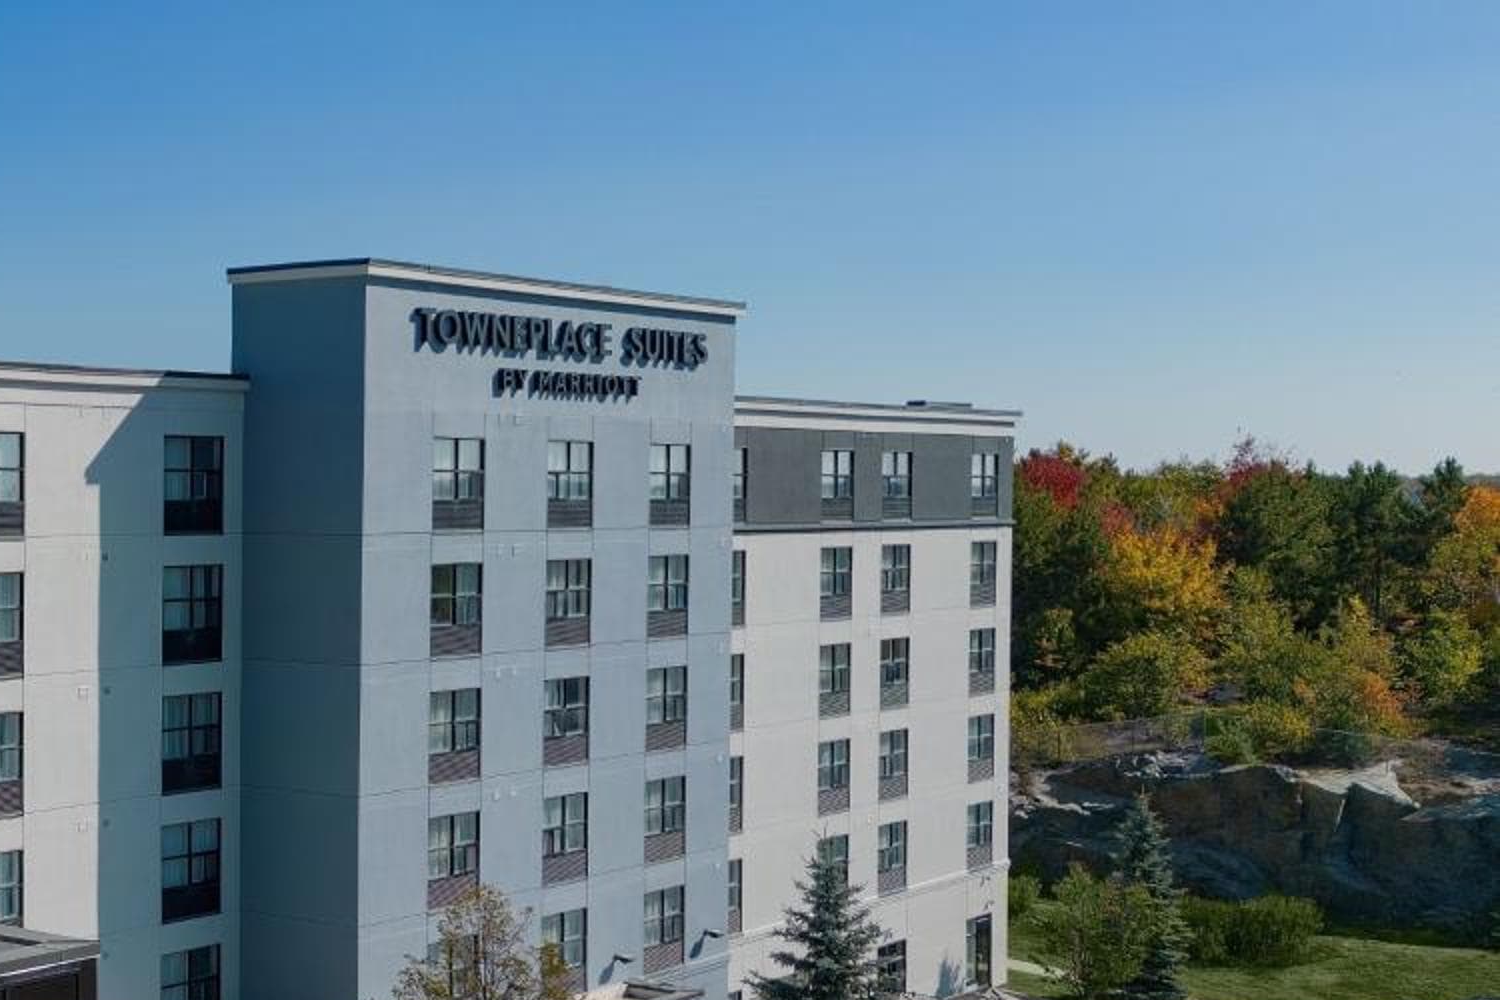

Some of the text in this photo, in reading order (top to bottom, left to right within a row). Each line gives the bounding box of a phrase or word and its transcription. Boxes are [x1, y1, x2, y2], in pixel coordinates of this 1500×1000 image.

[413, 307, 708, 368] TOWNEPLACE SUITES
[497, 368, 642, 400] BY MARRIOTT
